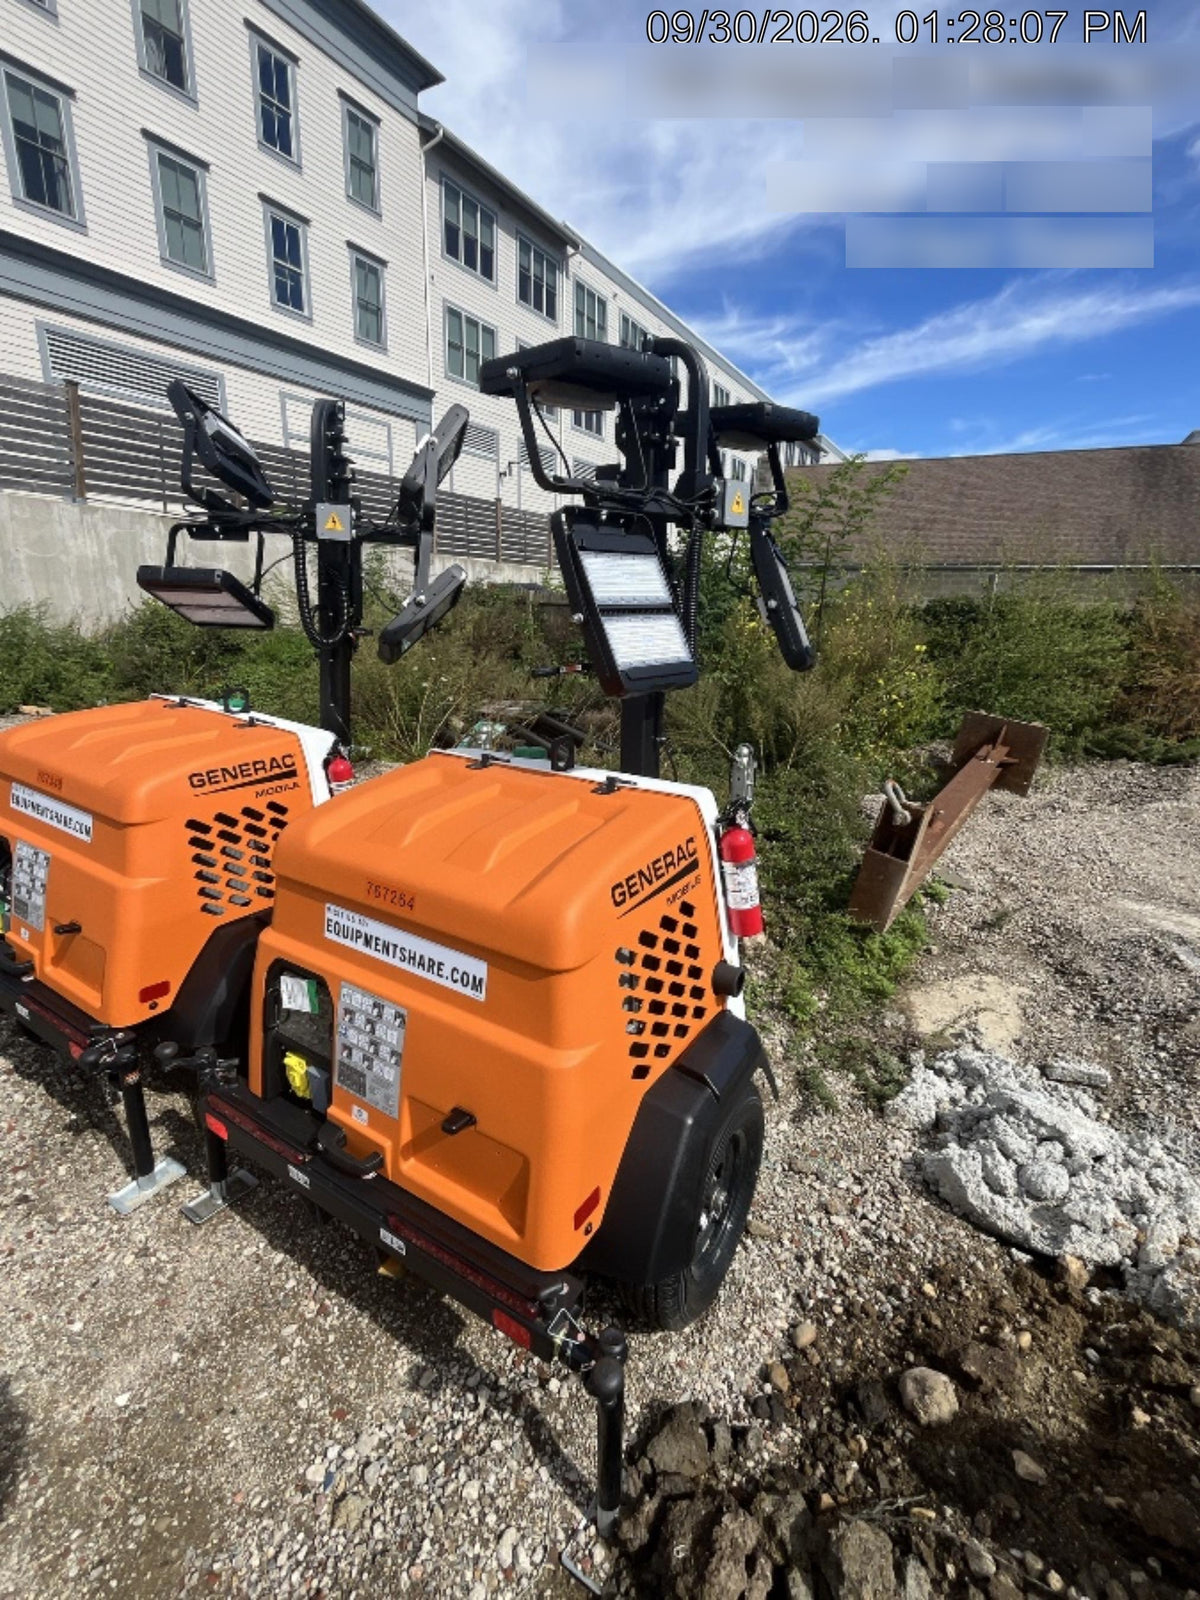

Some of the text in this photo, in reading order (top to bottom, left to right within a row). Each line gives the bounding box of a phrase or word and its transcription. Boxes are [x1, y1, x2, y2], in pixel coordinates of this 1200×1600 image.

[188, 754, 296, 789] GENERAC
[611, 836, 697, 907] GENERAC
[326, 917, 484, 995] EQUIPMENTSHARE.COM
